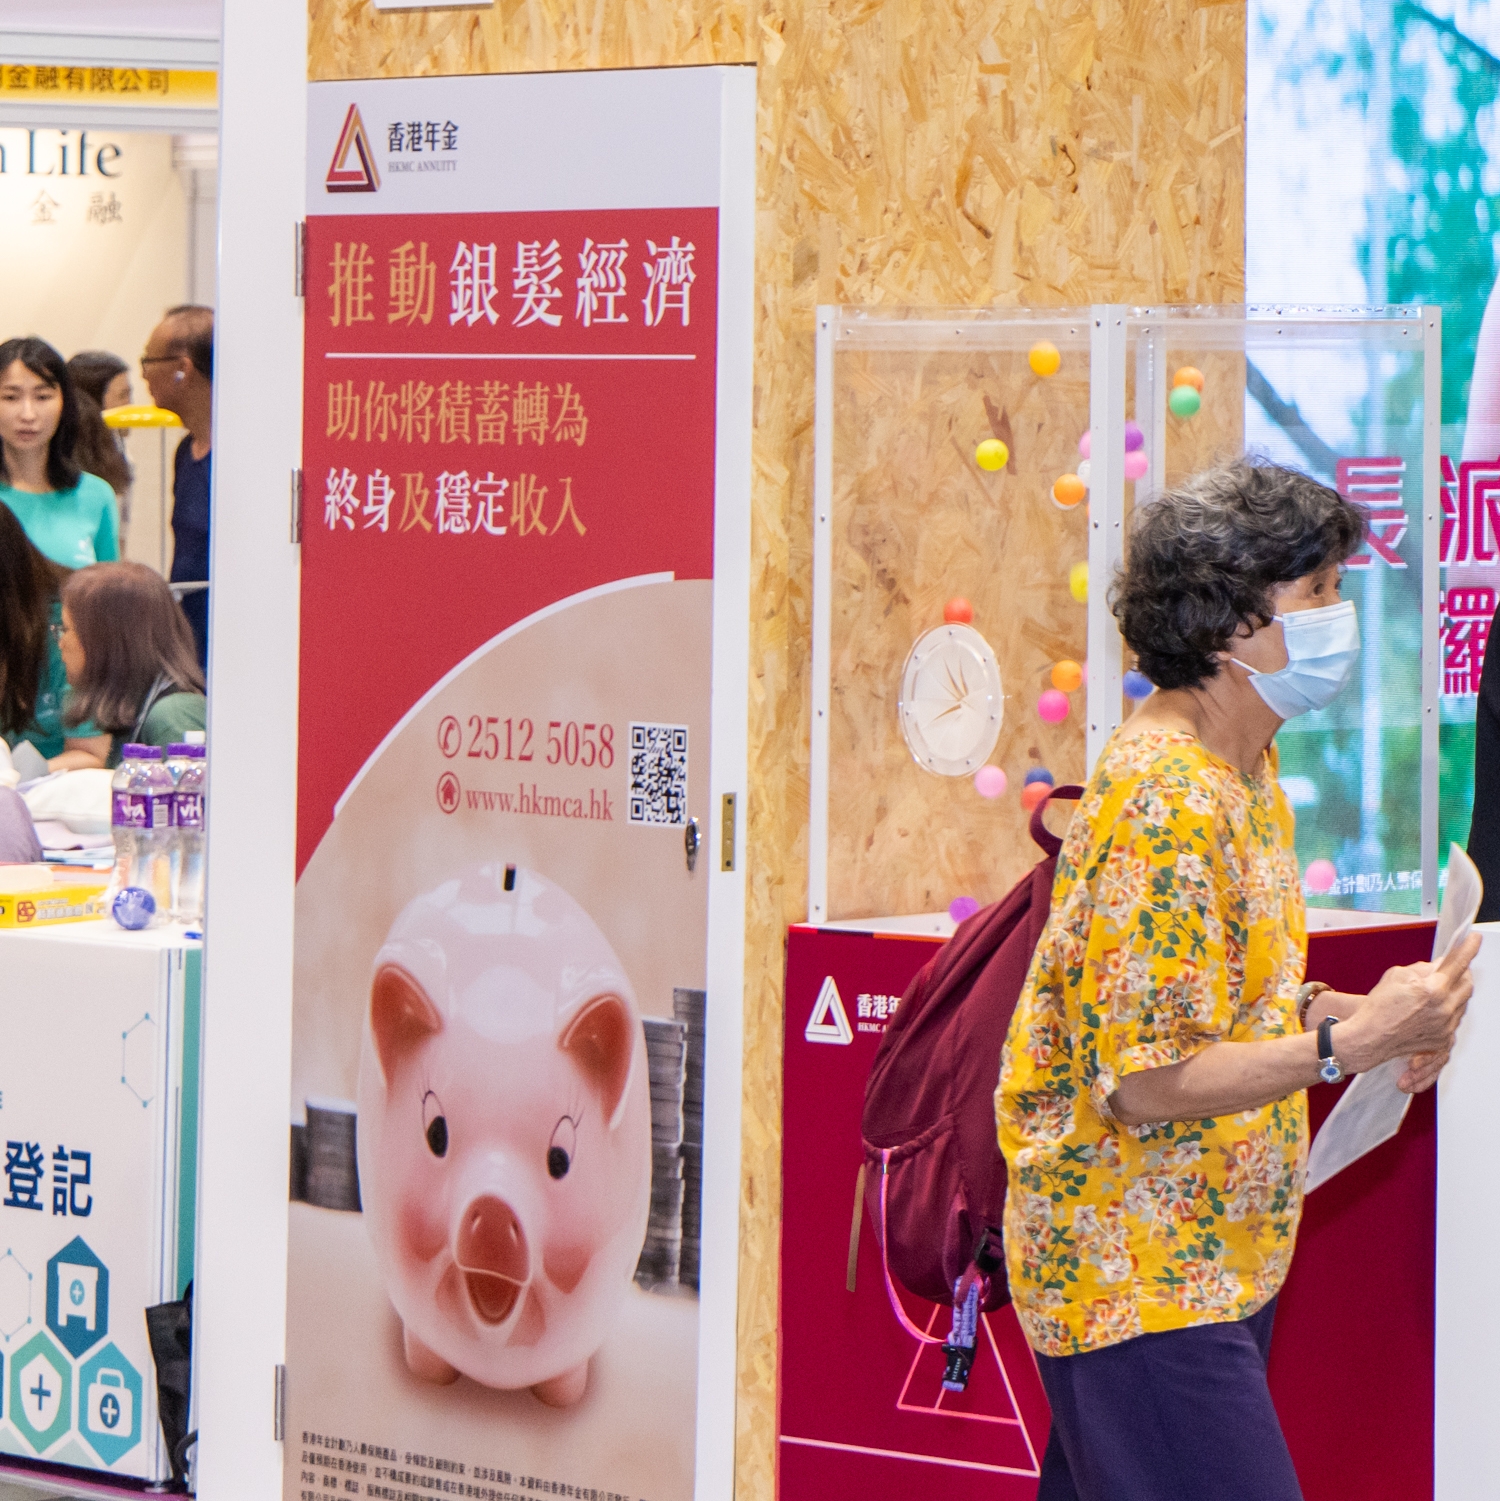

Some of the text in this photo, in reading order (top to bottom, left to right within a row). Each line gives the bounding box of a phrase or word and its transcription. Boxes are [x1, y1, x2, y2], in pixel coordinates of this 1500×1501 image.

[0, 63, 170, 95] 金融有限公司
[387, 120, 459, 153] 香港年金
[327, 235, 698, 328] 推動銀髮經濟
[325, 379, 590, 448] 助你將積蓄轉為
[323, 466, 589, 537] 終身及穩定收入
[466, 714, 615, 769] 2512 5058
[465, 782, 614, 821] www.hkmca.hk
[3, 1140, 93, 1217] 登記
